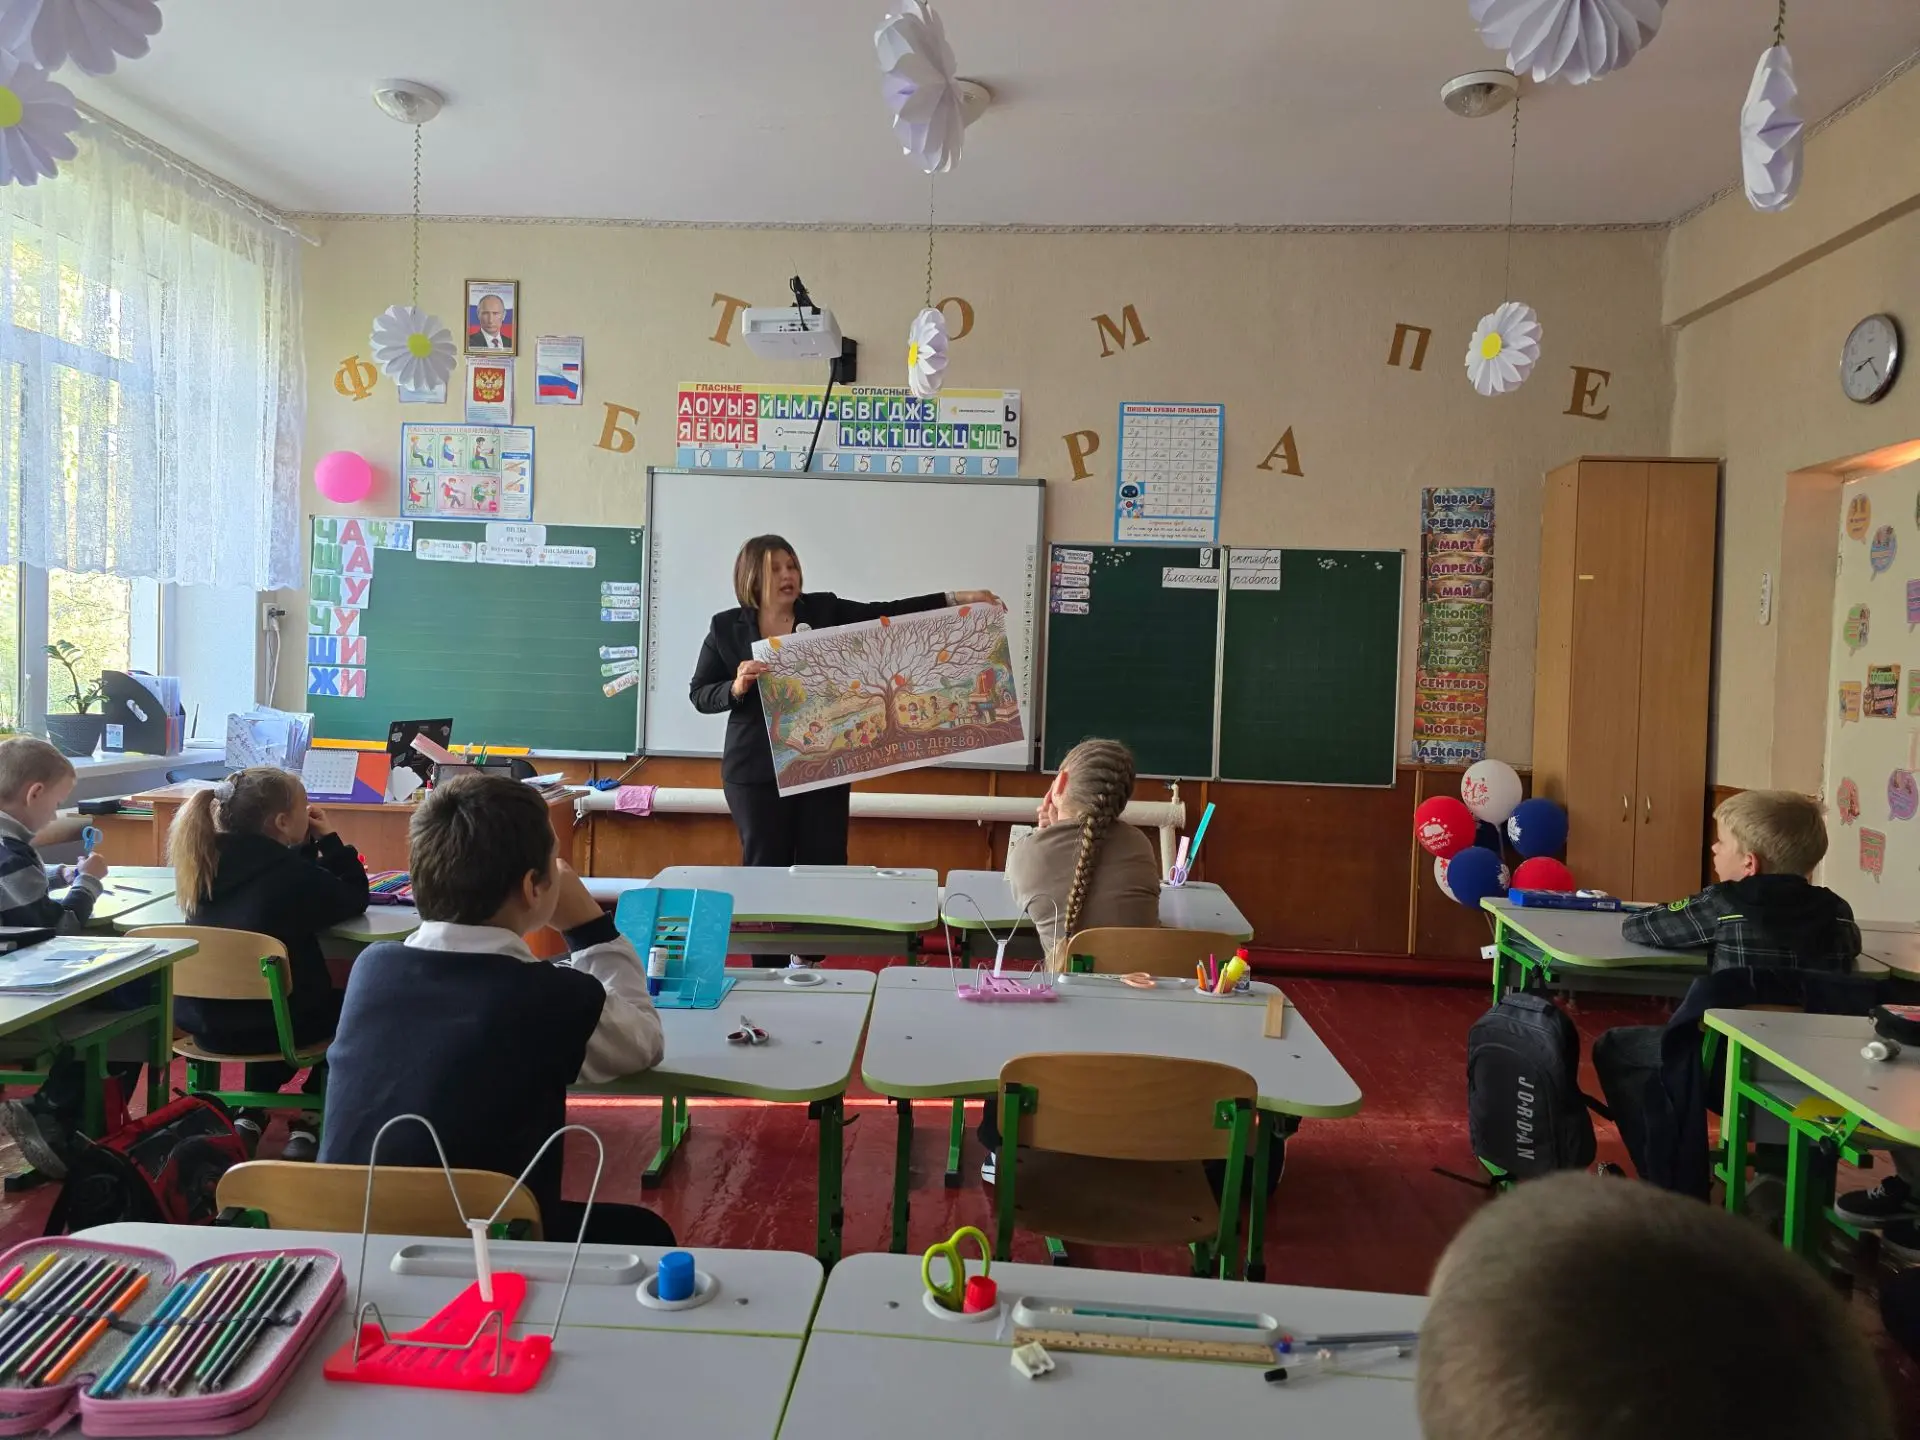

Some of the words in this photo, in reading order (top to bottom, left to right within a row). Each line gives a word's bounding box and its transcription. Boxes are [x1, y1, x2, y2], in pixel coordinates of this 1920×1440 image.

[1091, 303, 1150, 358] М
[1386, 322, 1432, 371] П
[695, 383, 742, 392] ГЛАСНЫЕ
[851, 387, 911, 397] СОГЛАСНЫЕ
[1562, 365, 1611, 420] Е
[593, 401, 640, 454] Б
[1062, 429, 1100, 482] Р
[1256, 425, 1305, 478] А
[1433, 494, 1484, 505] ЯНВАРЬ
[1427, 518, 1489, 528] ФЕВРАЛЬ
[1439, 540, 1475, 550] МАРТ
[1200, 548, 1212, 567] 9
[1431, 563, 1484, 574] АПРЕЛЬ
[1163, 567, 1218, 584] Классная
[1231, 569, 1279, 589] работа
[1442, 584, 1473, 596] МАЙ
[1434, 609, 1477, 619] ИЮНЬ
[1434, 632, 1477, 643] ИЮЛЬ
[1428, 655, 1478, 666] АВГУСТ
[1419, 678, 1485, 690] СЕНТЯБРЬ
[1422, 701, 1481, 713] ОКТЯБРЬ
[1424, 724, 1476, 736] НОЯБРЬ
[927, 735, 975, 749] ДЕРЕВО
[1418, 746, 1479, 759] ДЕКАБРЬ
[1516, 1076, 1536, 1160] JORDAN
